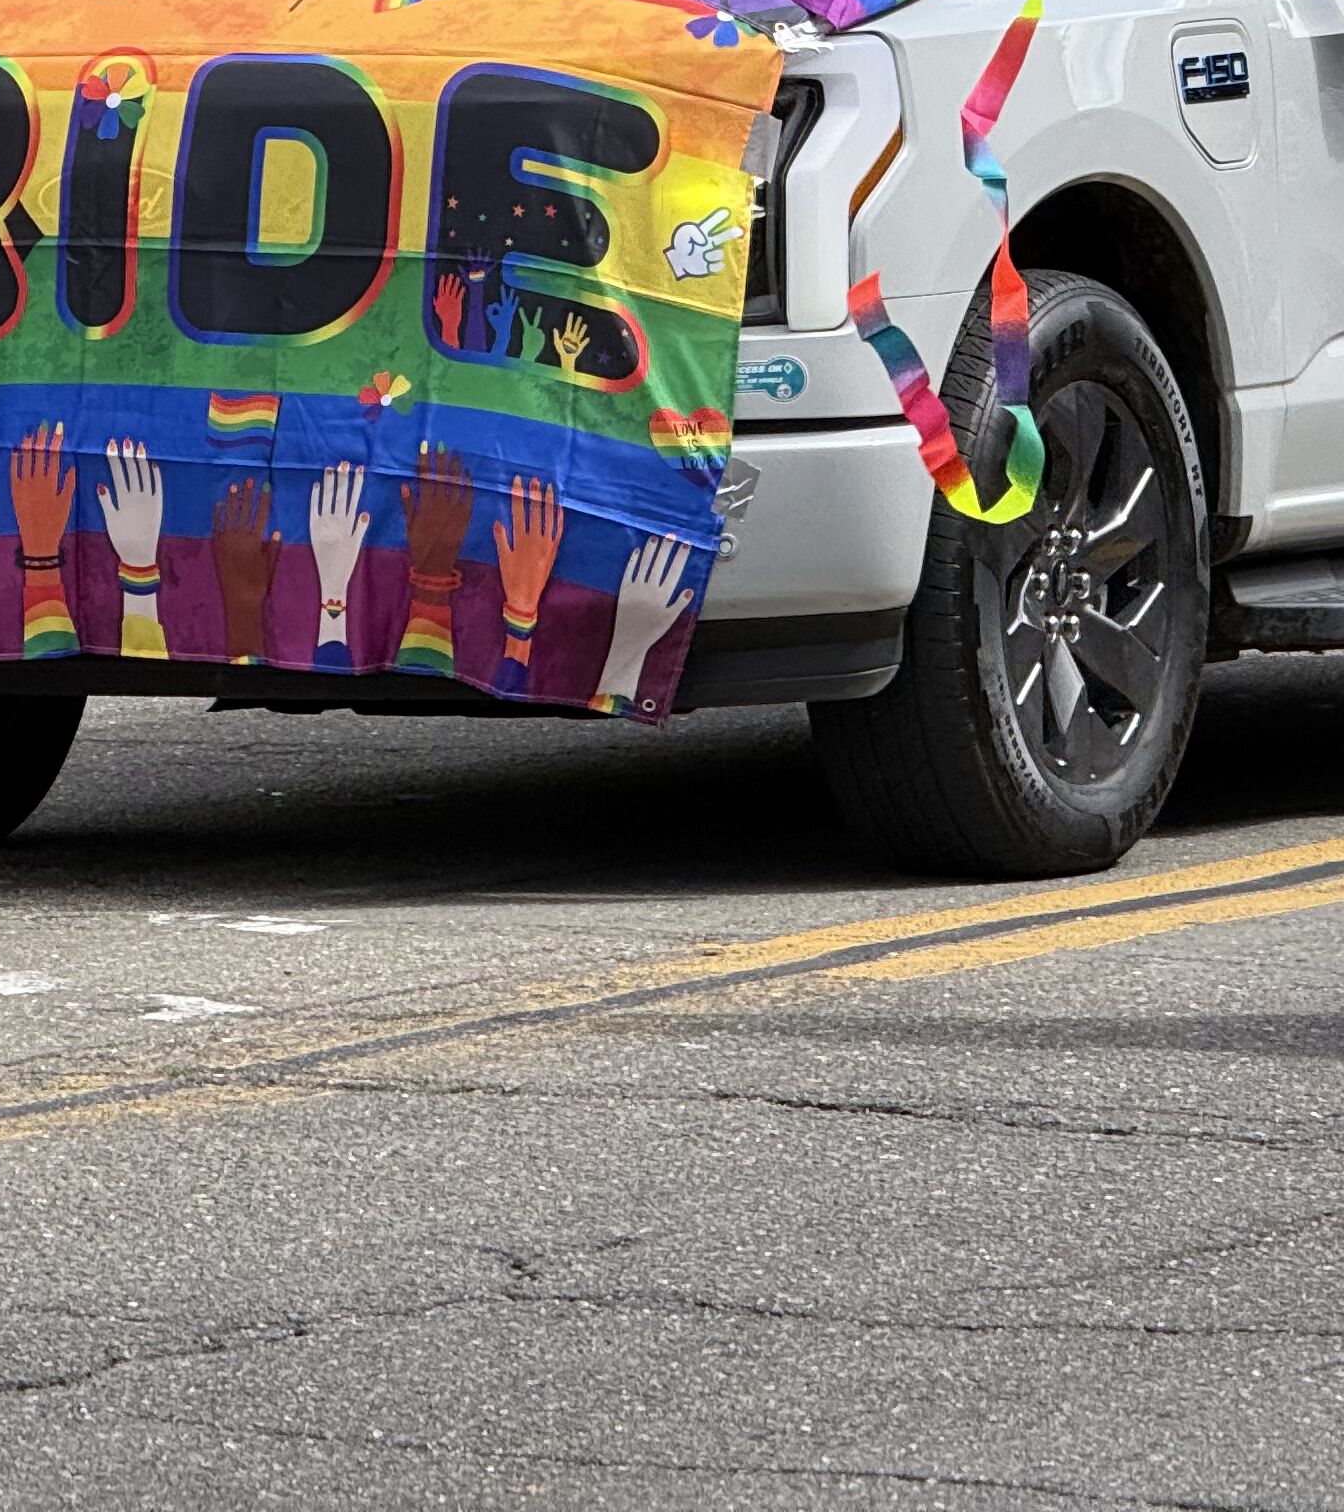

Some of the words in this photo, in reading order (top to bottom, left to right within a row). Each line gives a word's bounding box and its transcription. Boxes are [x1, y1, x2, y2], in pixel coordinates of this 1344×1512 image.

[1179, 51, 1249, 90] F-150
[673, 421, 705, 438] LOVE
[687, 439, 700, 453] IS
